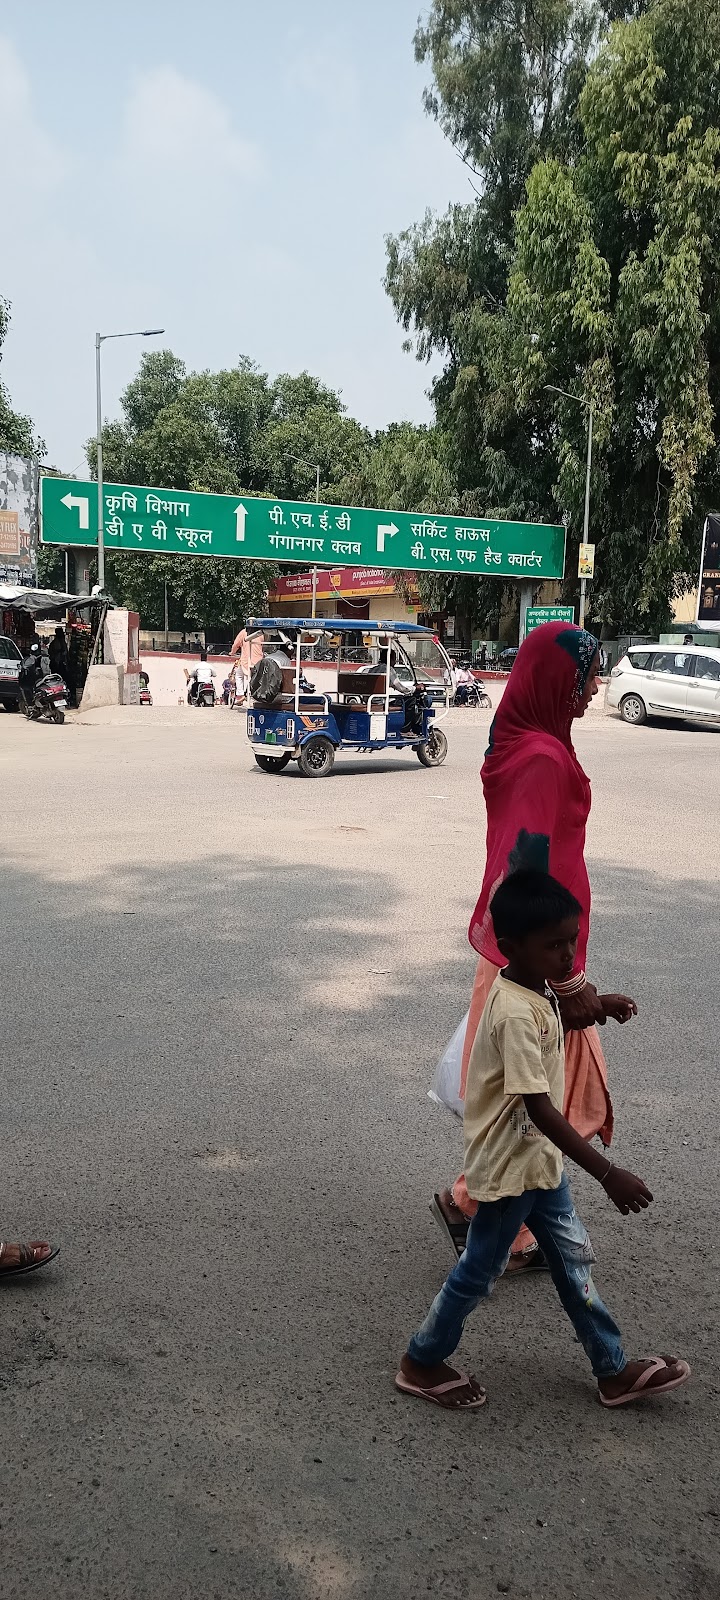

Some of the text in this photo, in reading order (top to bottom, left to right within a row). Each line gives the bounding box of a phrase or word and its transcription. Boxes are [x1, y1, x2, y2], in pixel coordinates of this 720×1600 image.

[105, 492, 190, 517] कृषि विभाग
[268, 505, 351, 531] पी. एच. ई. डी
[105, 516, 213, 548] डी ए वी स्कूल
[268, 531, 362, 555] गंगानगर क्लब
[410, 520, 491, 542] सर्किट हाऊस
[410, 541, 543, 568] बी. एस. एफ हैड क्वार्टर
